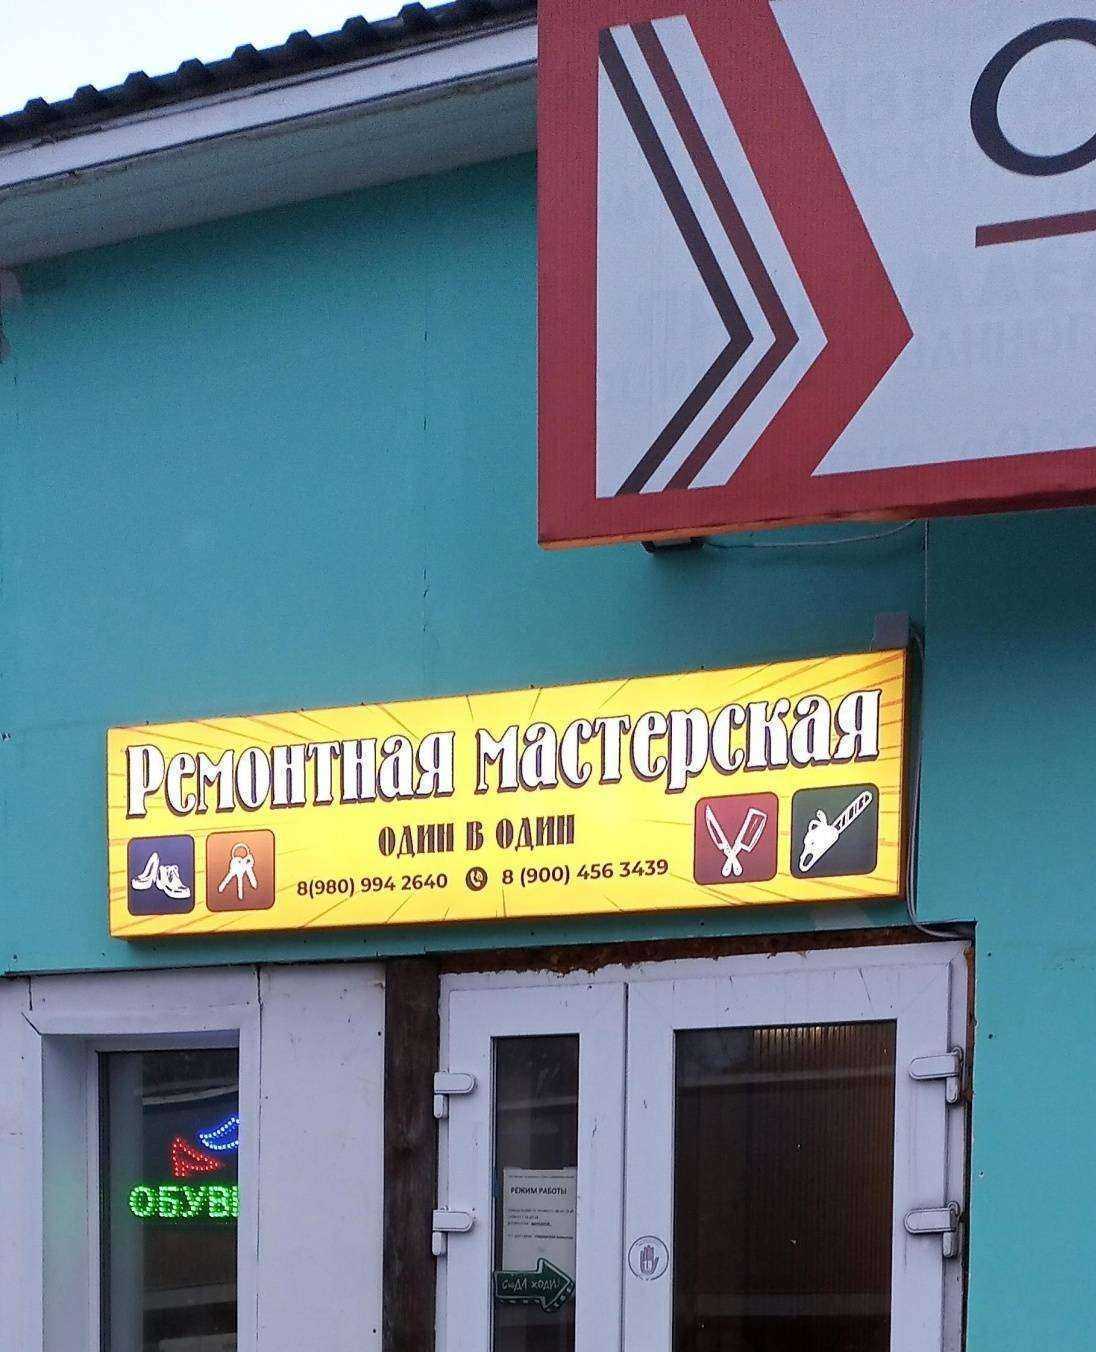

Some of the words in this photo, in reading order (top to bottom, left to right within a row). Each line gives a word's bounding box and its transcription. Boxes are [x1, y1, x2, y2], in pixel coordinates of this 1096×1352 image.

[126, 731, 456, 820] Ремонтная
[473, 689, 882, 794] мастерская
[297, 878, 355, 899] 8(980)
[361, 876, 396, 892] 994
[401, 873, 448, 890] 2640
[502, 869, 513, 885] 8
[520, 865, 570, 887] (900)
[576, 862, 614, 880] 456
[619, 859, 668, 878] 3439
[510, 1187, 538, 1195] РЕЖИМ
[538, 1187, 567, 1195] РАБОТЫ
